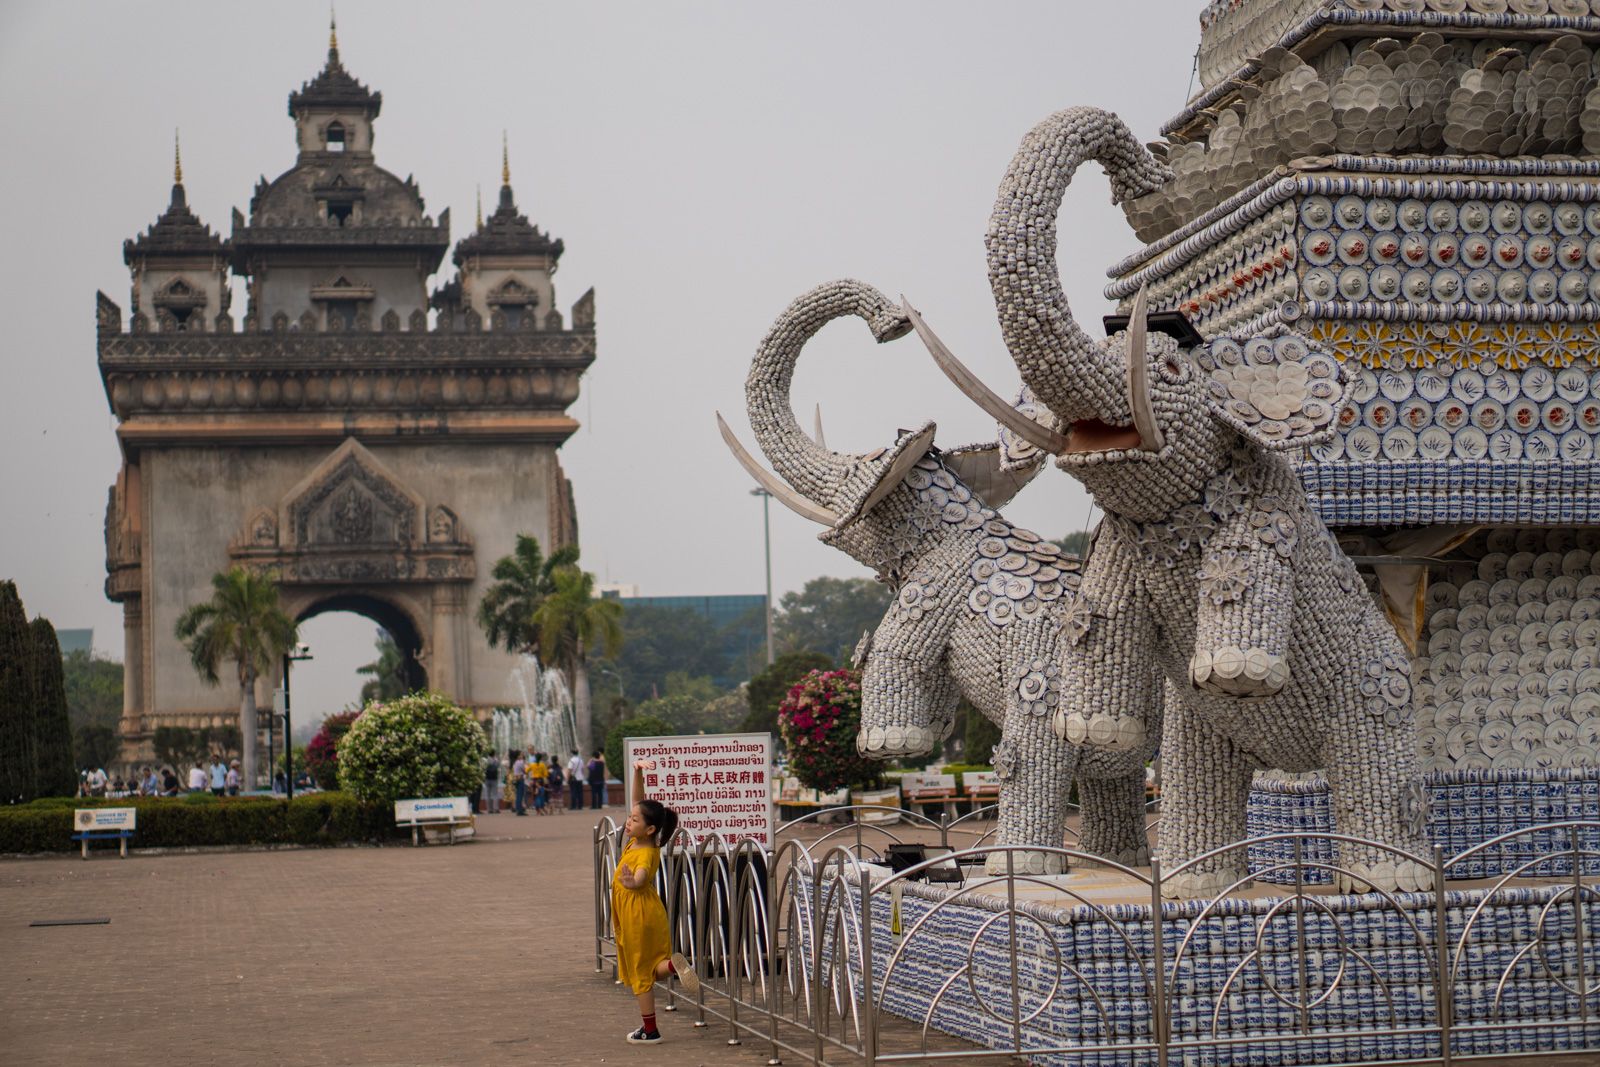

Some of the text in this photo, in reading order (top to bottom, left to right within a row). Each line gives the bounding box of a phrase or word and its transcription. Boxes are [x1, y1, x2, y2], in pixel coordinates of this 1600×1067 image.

[643, 772, 764, 787] 国·自贡市人民政府赠
